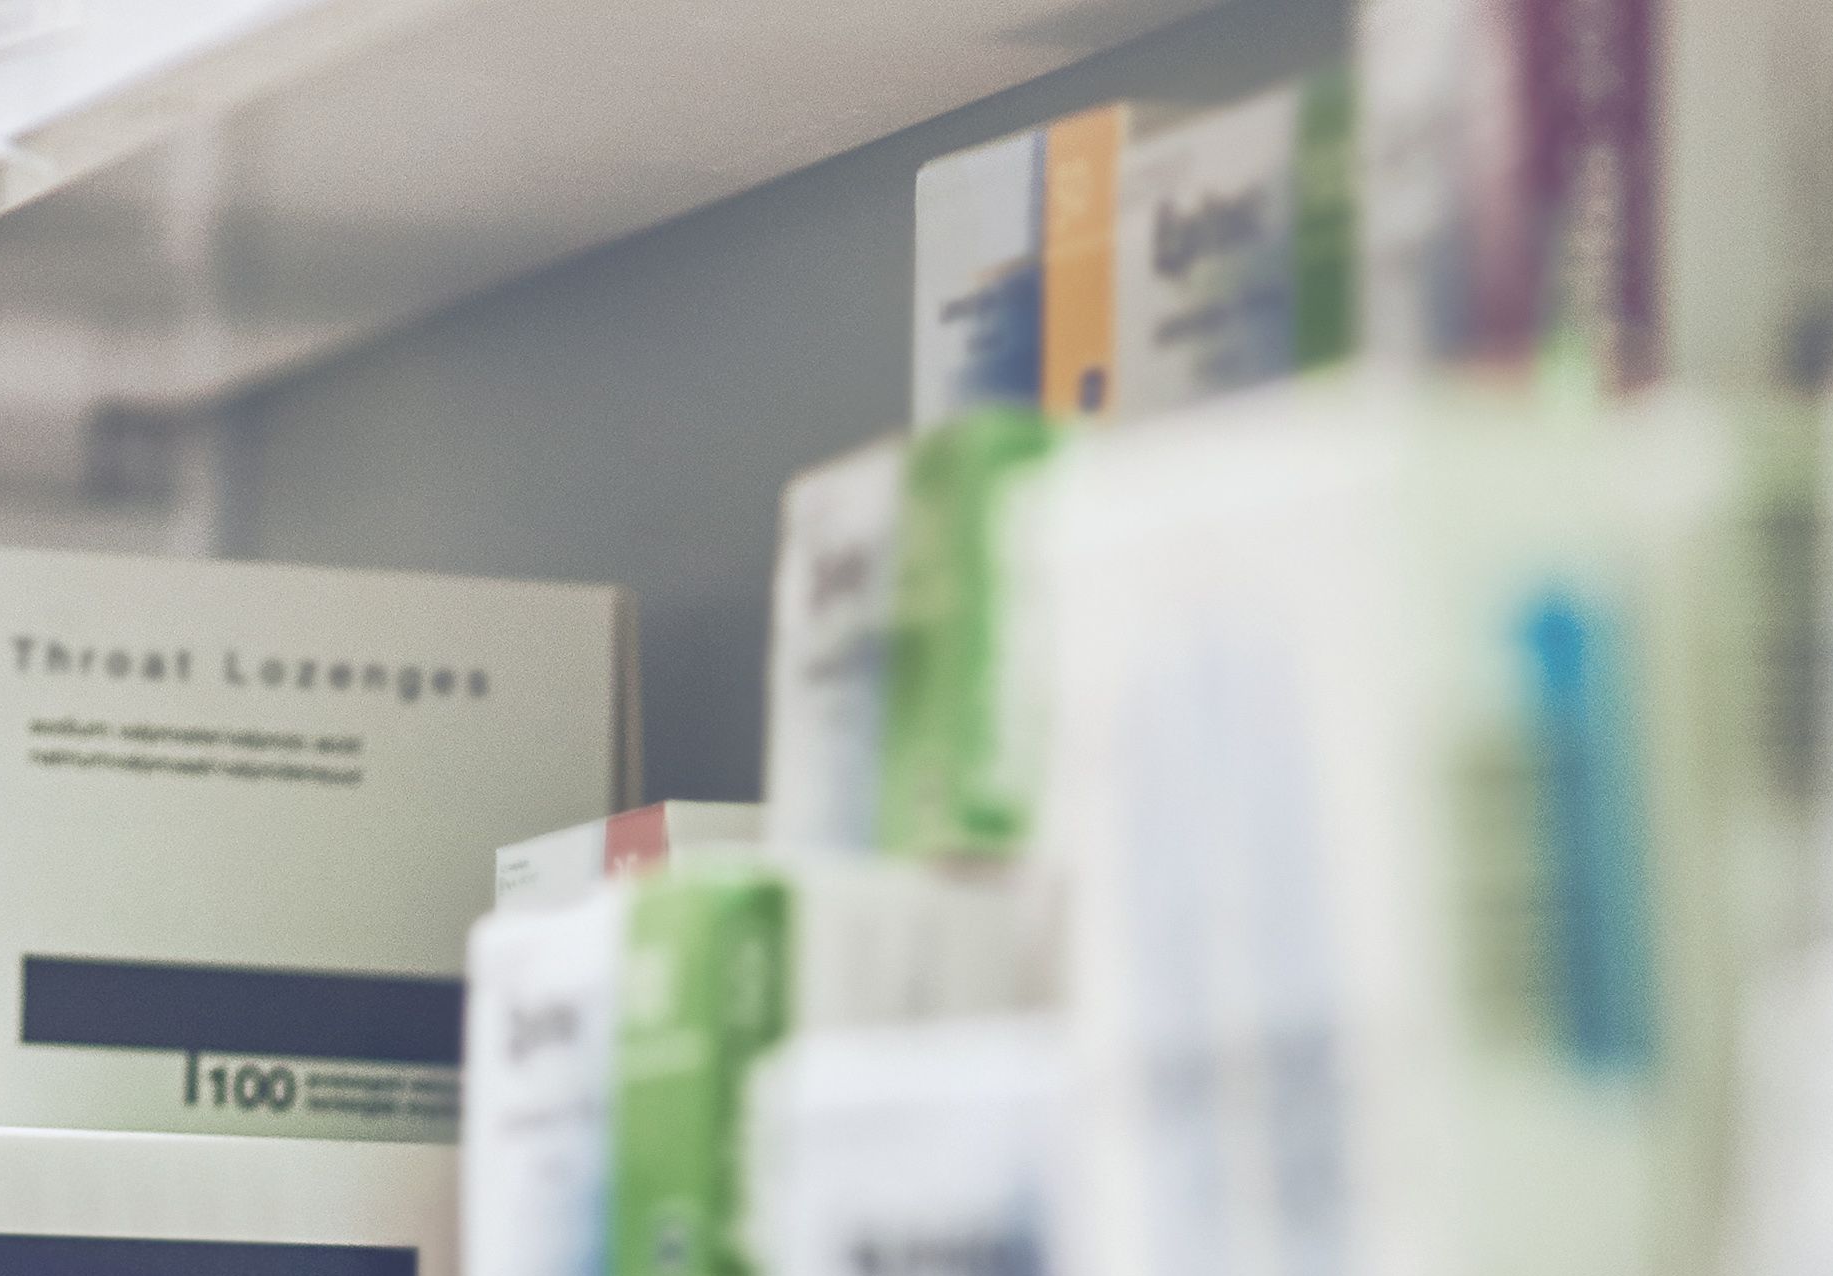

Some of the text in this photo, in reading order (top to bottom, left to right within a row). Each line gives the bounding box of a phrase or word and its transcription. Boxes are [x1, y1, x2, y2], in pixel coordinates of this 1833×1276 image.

[11, 635, 490, 702] Throat Lozenges
[209, 1063, 297, 1112] 100
